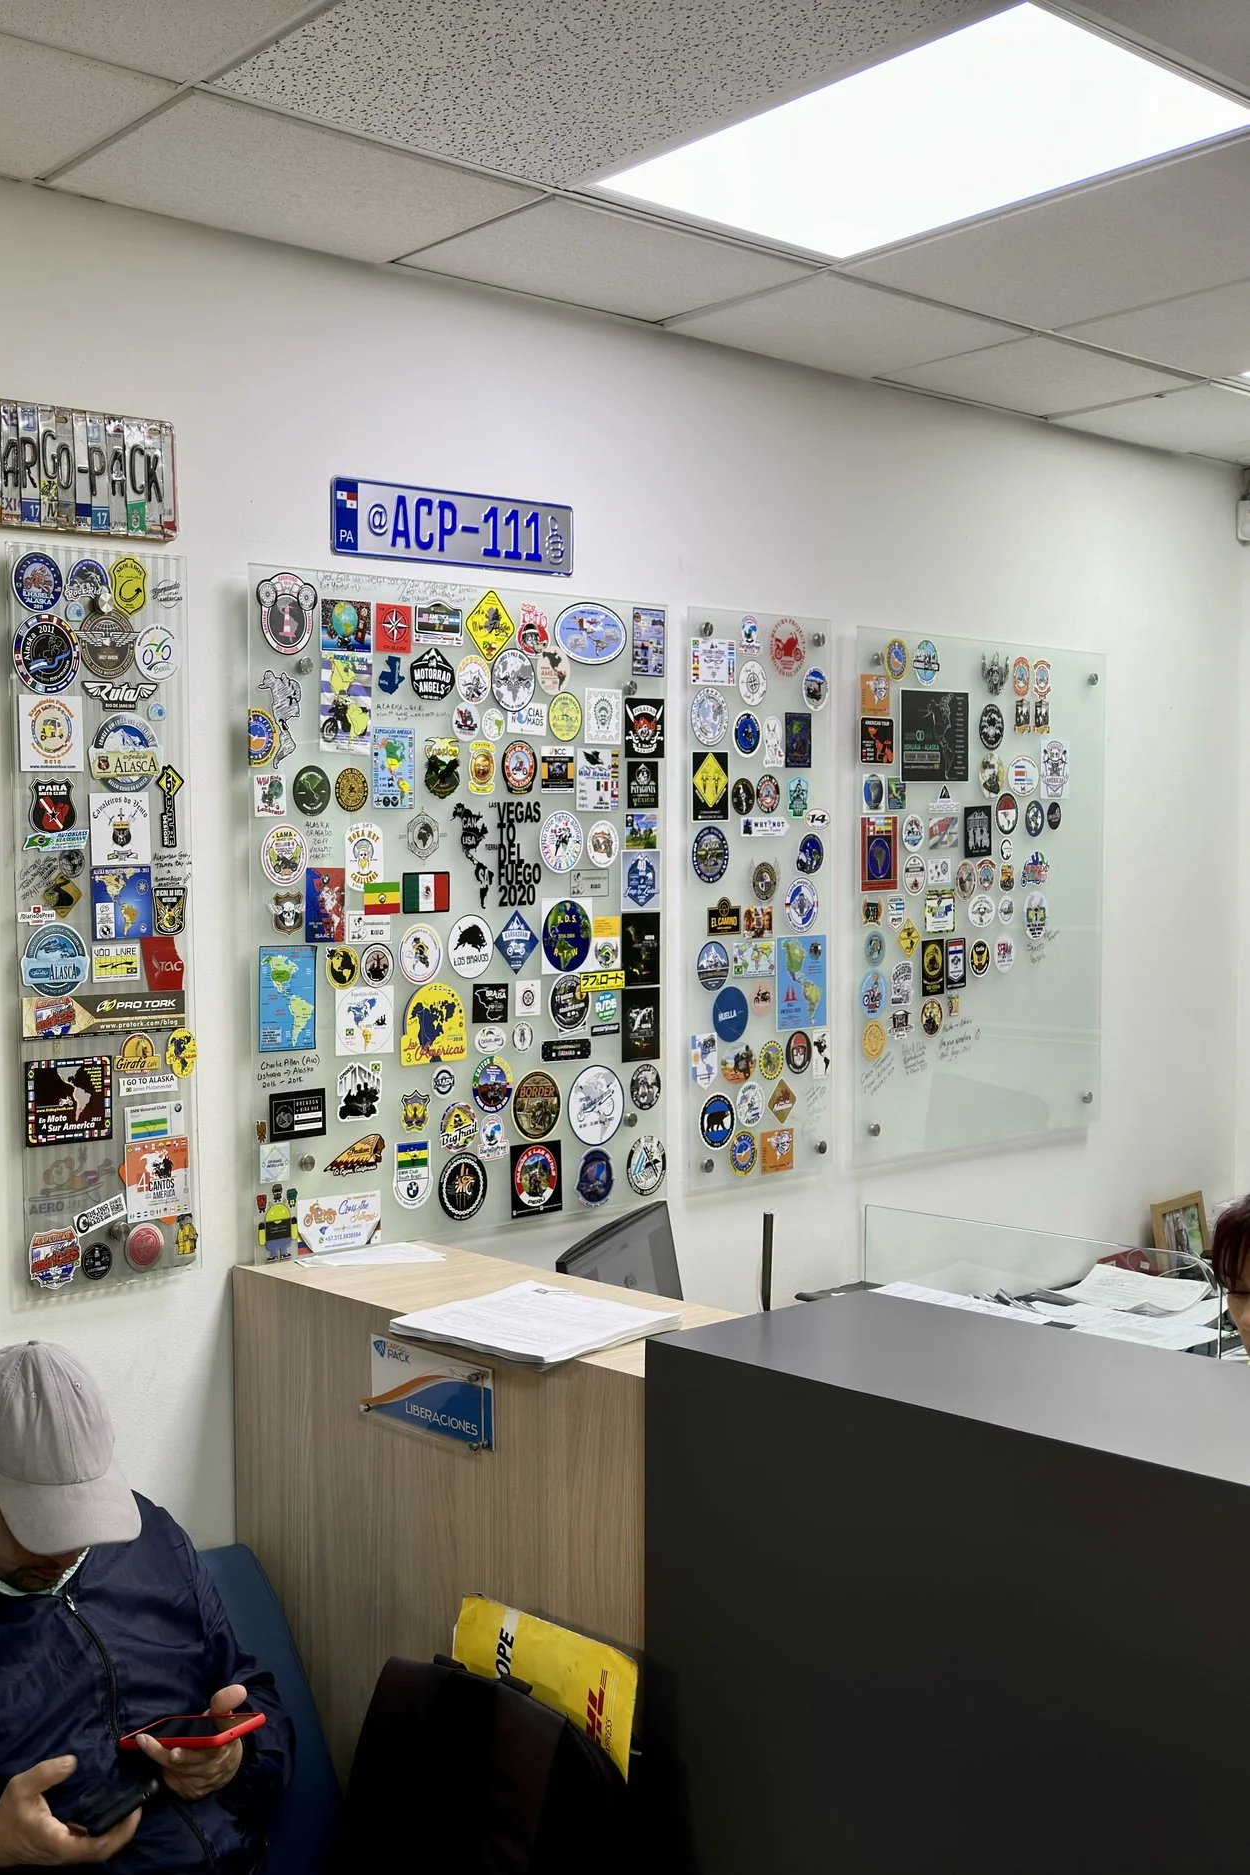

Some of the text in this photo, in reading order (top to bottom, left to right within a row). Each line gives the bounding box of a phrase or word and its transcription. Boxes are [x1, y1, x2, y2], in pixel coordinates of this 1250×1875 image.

[368, 495, 542, 562] @ACP-111
[339, 530, 354, 543] PA
[22, 590, 55, 599] ILHABELA
[24, 625, 55, 661] Alaska 2011
[414, 668, 450, 682] MOTORRAD
[419, 681, 445, 695] ANGELS
[114, 757, 158, 773] ALASCA
[38, 783, 67, 791] PARÁ
[497, 801, 541, 823] VEGAS
[810, 814, 826, 823] 14
[497, 822, 516, 844] TO
[462, 836, 476, 845] USA
[485, 843, 524, 864] TIERRA DEL
[498, 863, 541, 885] FUEGO
[499, 884, 536, 907] 2020
[711, 917, 738, 927] EL CAMINO
[116, 947, 136, 955] LIVRE
[116, 999, 177, 1010] PRO TORK
[719, 1010, 737, 1021] HUELLA
[100, 1018, 178, 1030] www.protork.com/blog
[115, 1058, 146, 1071] Girafa
[519, 1085, 554, 1097] BORDER
[47, 1115, 68, 1123] Moto
[48, 1124, 62, 1132] Sur
[64, 1121, 96, 1130] America
[440, 1122, 480, 1147] BigTrail
[149, 1179, 175, 1191] CANTOS
[528, 1197, 546, 1205] PERU
[387, 1348, 411, 1364] PACK
[405, 1400, 478, 1436] LIBERACIONES
